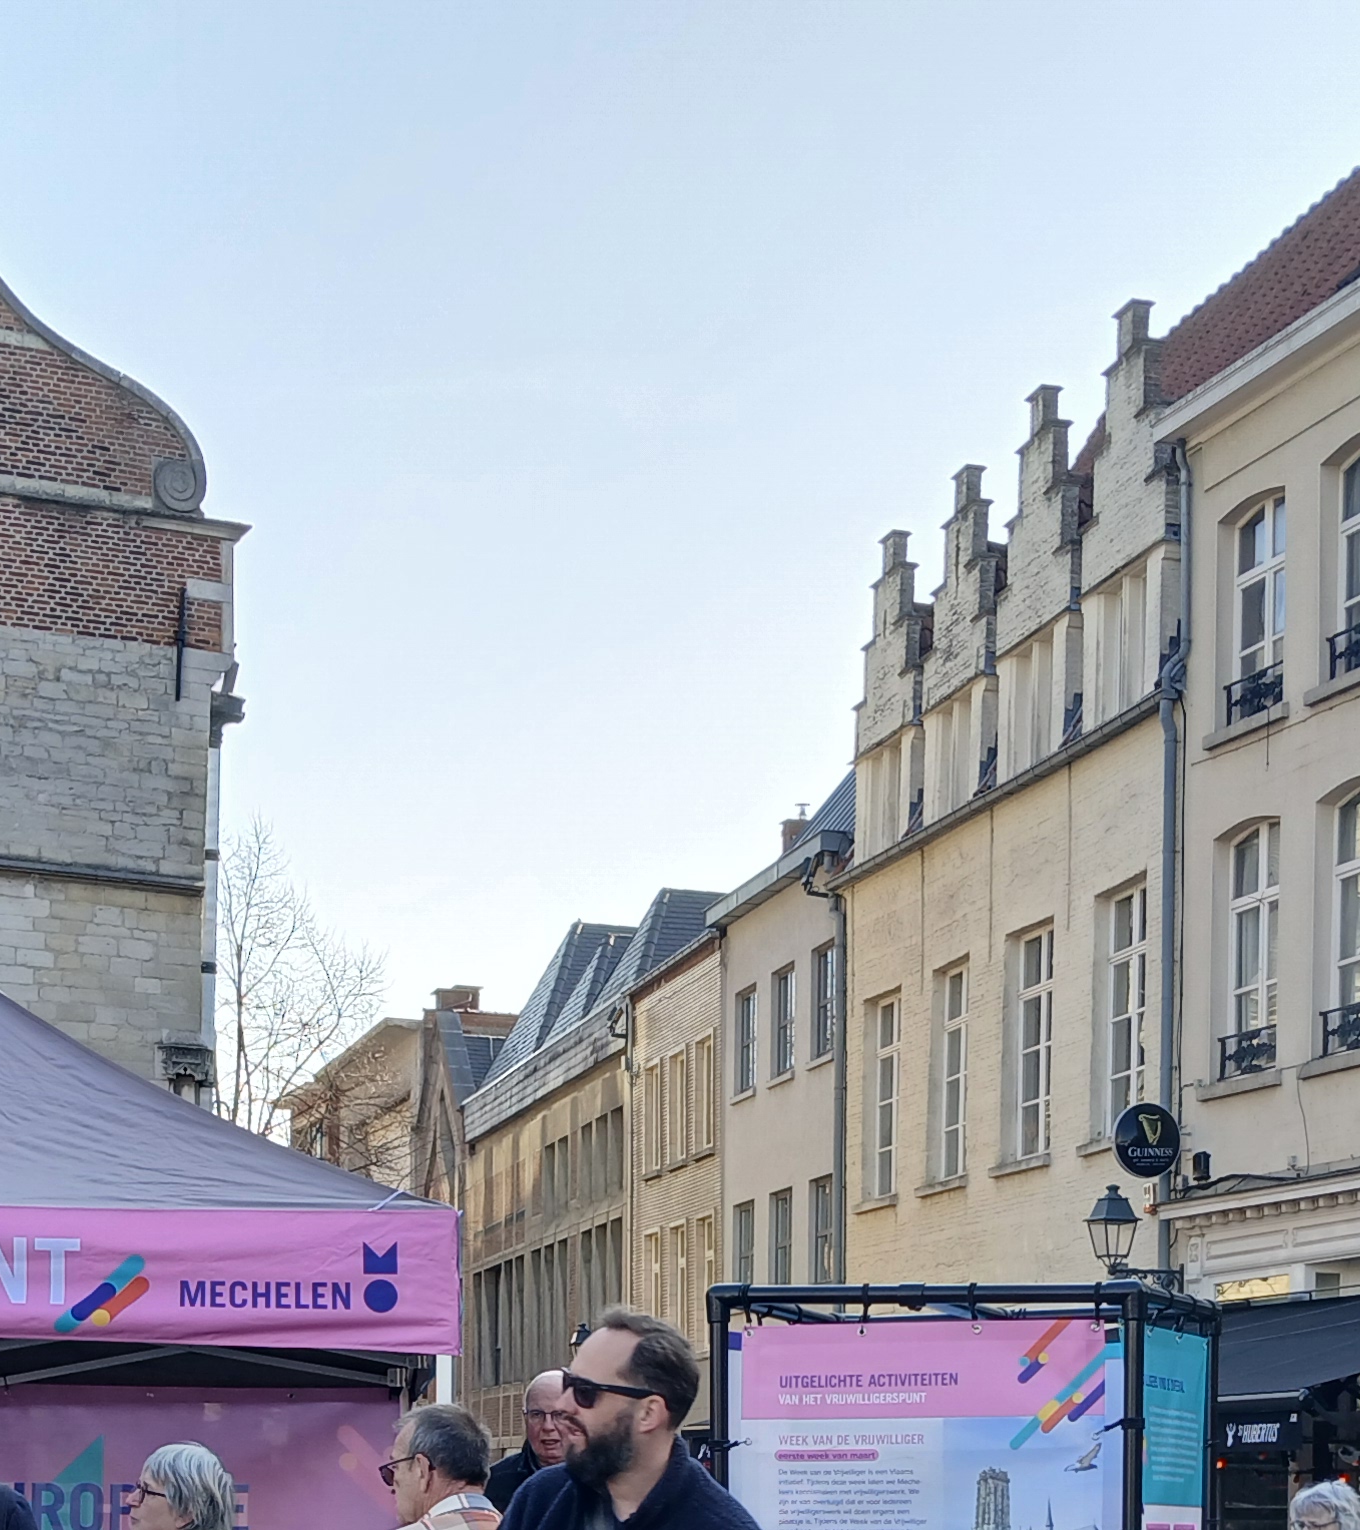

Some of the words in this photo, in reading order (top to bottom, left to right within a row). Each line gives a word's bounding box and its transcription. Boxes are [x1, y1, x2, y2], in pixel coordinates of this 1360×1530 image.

[1127, 1146, 1174, 1158] GUINNESS
[178, 1279, 352, 1311] MECHELEN
[779, 1374, 864, 1389] UITGELICHTE
[868, 1372, 959, 1388] ACTIVITEITEN
[778, 1394, 799, 1406] VAN
[802, 1393, 823, 1405] HET
[1242, 1422, 1280, 1444] HUBERTUS
[778, 1434, 809, 1446] WEEK
[811, 1434, 834, 1446] VAN
[836, 1434, 851, 1446] DE
[778, 1452, 805, 1460] eerste
[807, 1450, 829, 1460] week
[832, 1452, 848, 1460] van
[850, 1452, 876, 1460] maart
